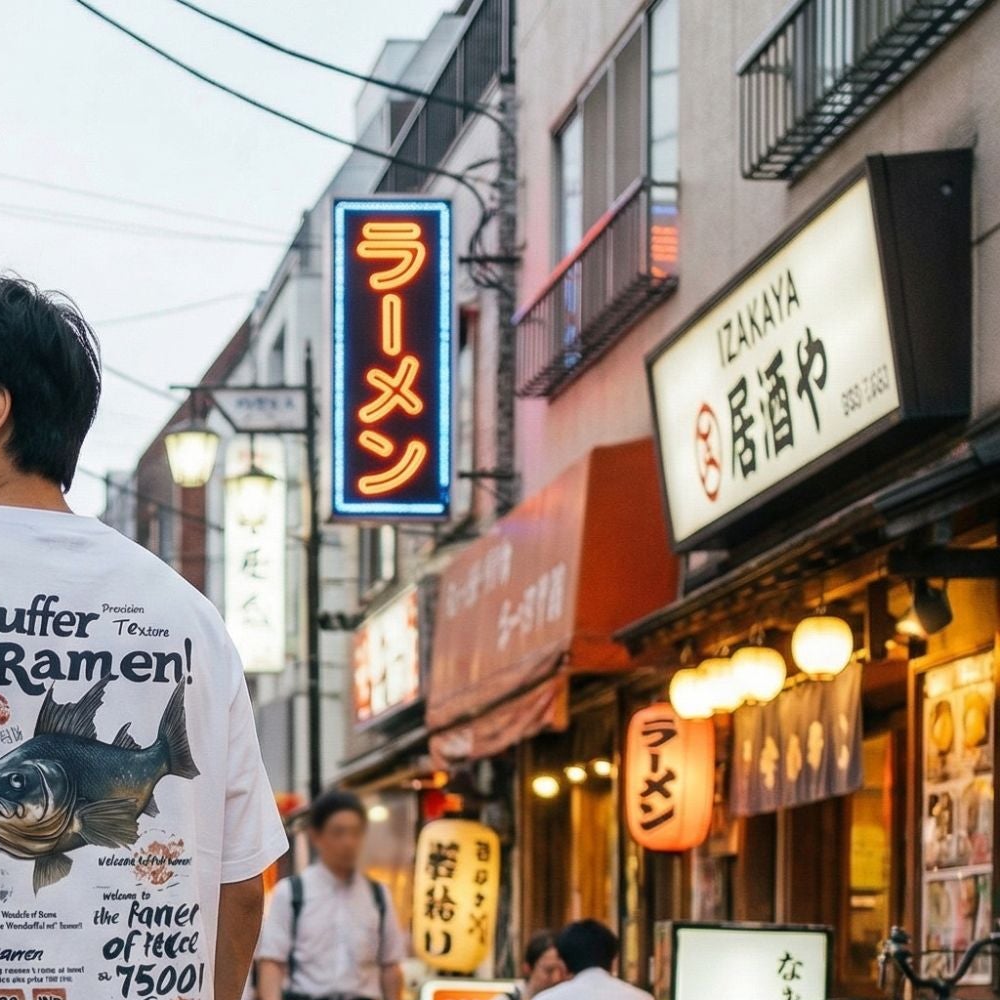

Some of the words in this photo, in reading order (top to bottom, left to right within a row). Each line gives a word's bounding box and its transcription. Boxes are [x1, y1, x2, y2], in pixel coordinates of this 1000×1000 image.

[355, 222, 427, 495] ラーメン
[716, 268, 802, 369] IZAKAYA
[726, 327, 829, 480] 居酒や
[640, 719, 676, 832] ラーメン
[102, 929, 143, 963] of
